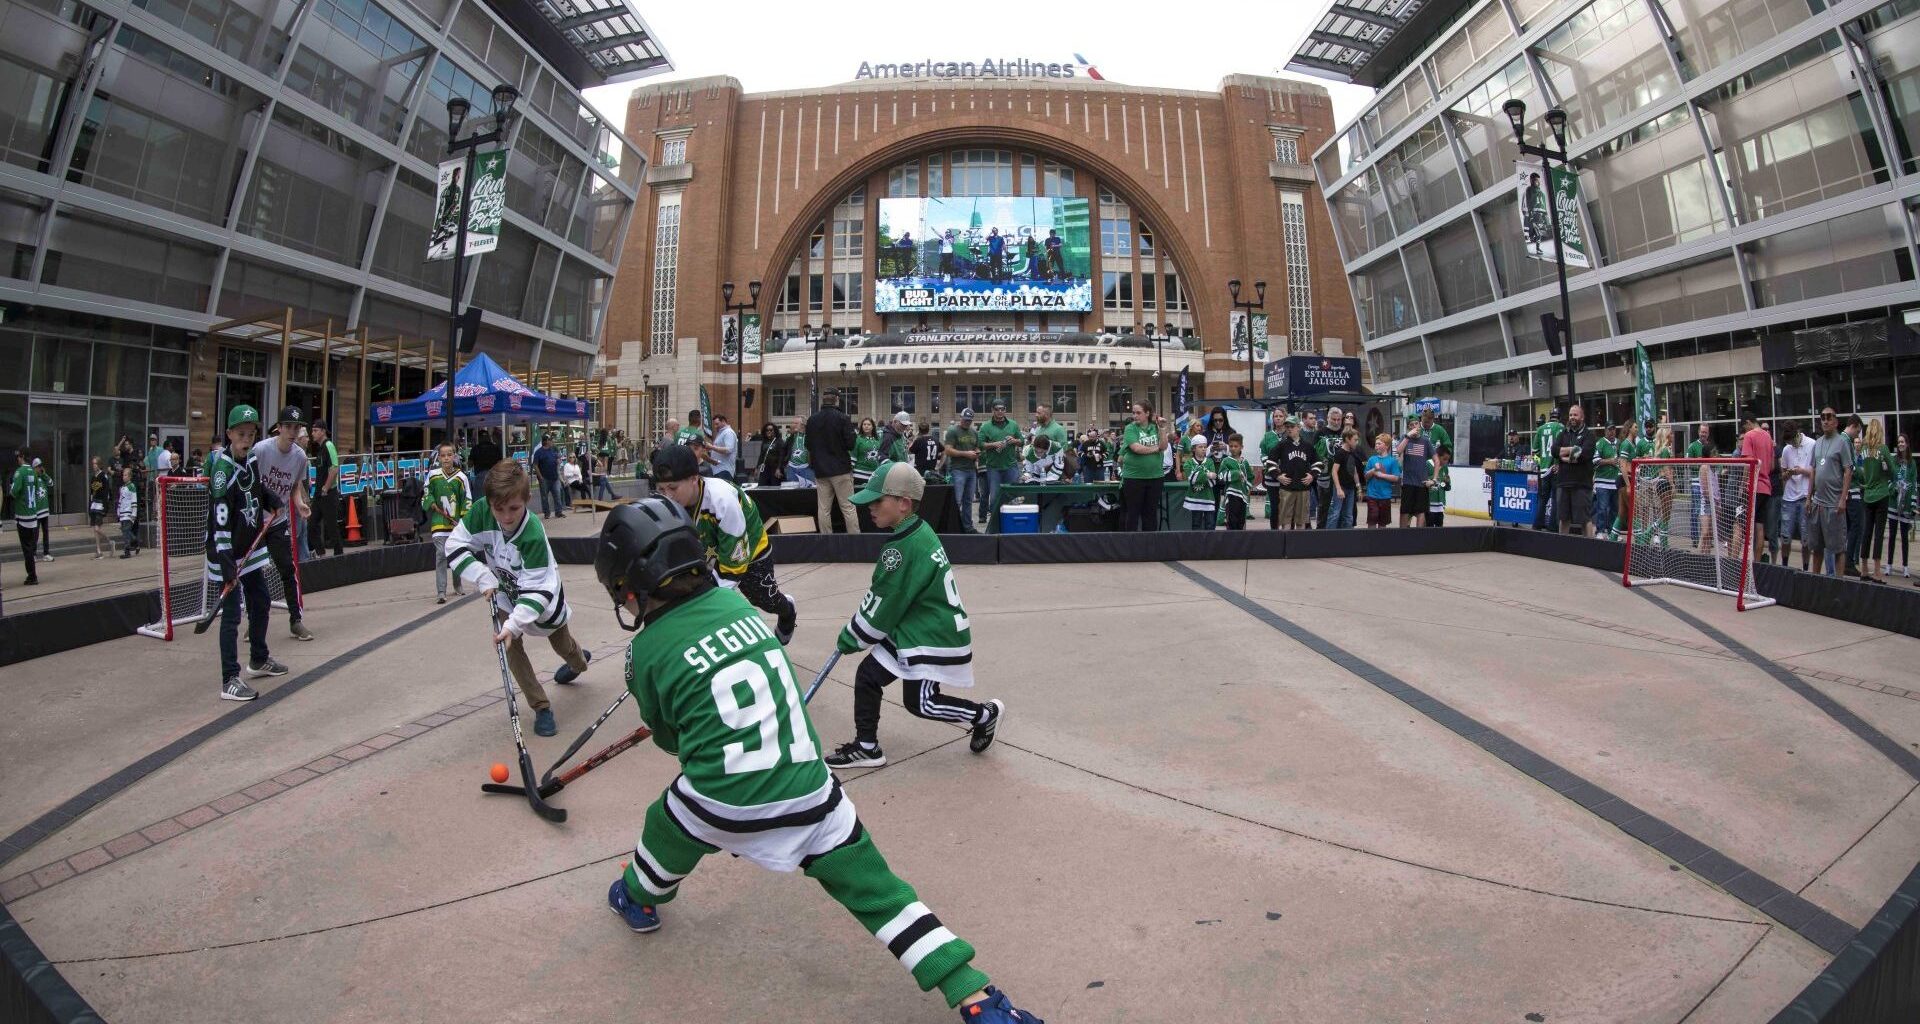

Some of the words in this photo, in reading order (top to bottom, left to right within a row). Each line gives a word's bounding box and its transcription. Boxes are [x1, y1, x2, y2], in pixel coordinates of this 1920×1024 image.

[855, 58, 977, 79] American
[978, 57, 1075, 79] Airlines
[905, 289, 929, 298] BUD
[900, 298, 933, 307] LIGHT
[937, 295, 991, 307] PARTY
[1011, 295, 1066, 307] PLAZA
[908, 334, 954, 343] STANLEY
[975, 333, 1028, 341] PLAYOFFS
[1304, 370, 1350, 379] ESTRELLA
[1308, 378, 1346, 386] JALISCO
[927, 445, 938, 460] 14
[1288, 450, 1307, 461] DALLAS
[269, 465, 292, 479] Plano
[1503, 486, 1528, 499] BUD
[1499, 496, 1532, 511] LIGHT
[861, 591, 883, 619] 91
[711, 648, 819, 774] 91
